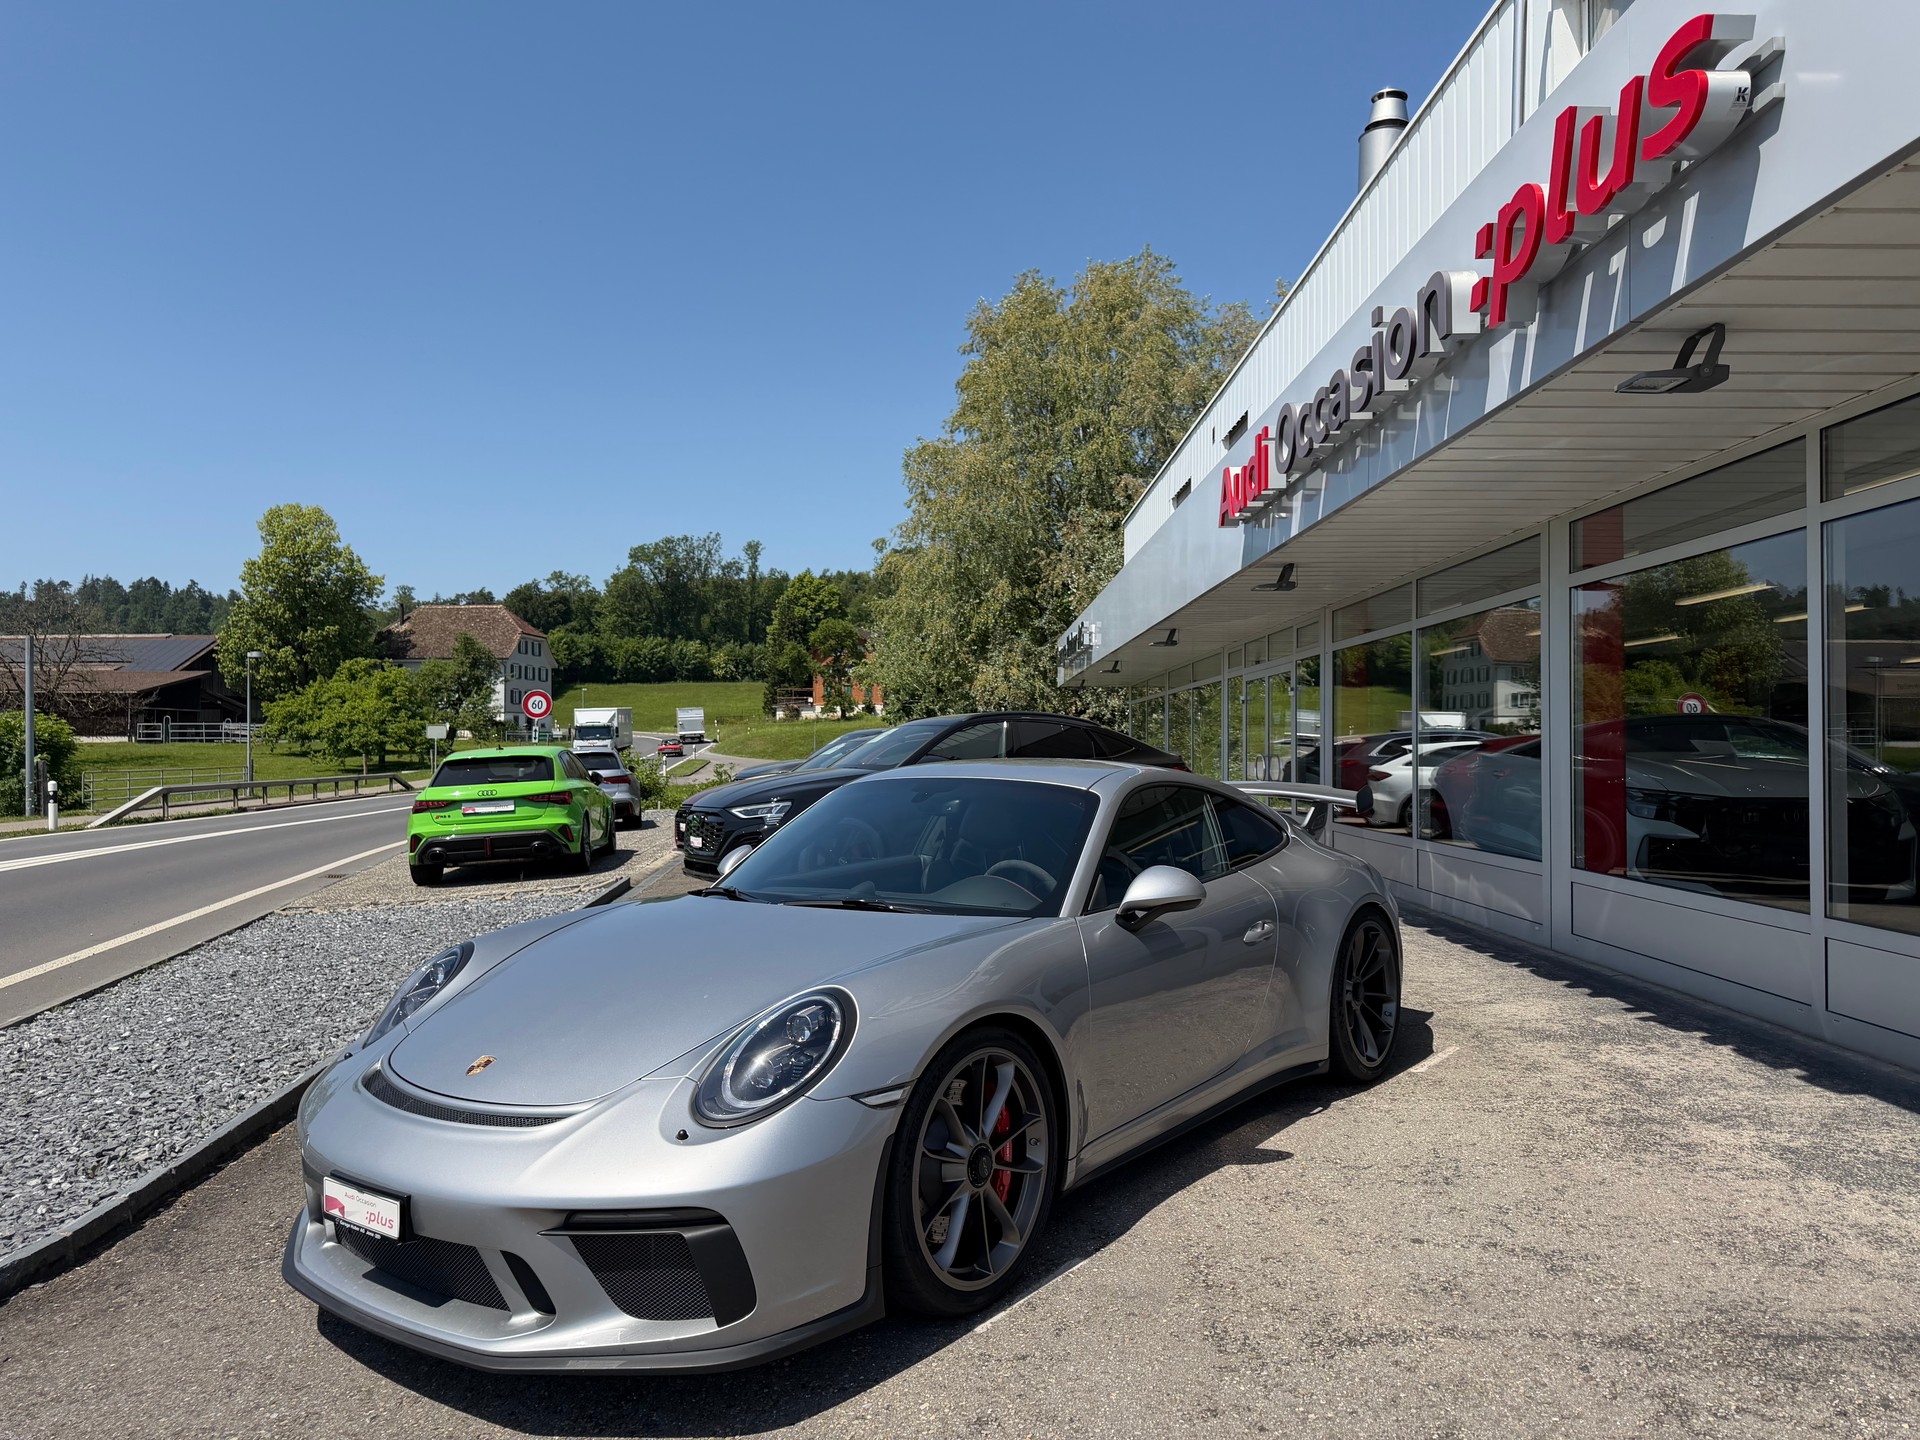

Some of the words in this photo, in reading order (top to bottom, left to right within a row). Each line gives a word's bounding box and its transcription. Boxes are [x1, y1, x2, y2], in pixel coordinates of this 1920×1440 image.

[1218, 426, 1269, 528] Audi
[1275, 271, 1451, 474] Occasion
[1470, 14, 1715, 329] :plus
[531, 700, 543, 710] 60
[345, 1192, 355, 1201] Audi
[356, 1195, 377, 1208] Occasion
[365, 1211, 394, 1229] :plus
